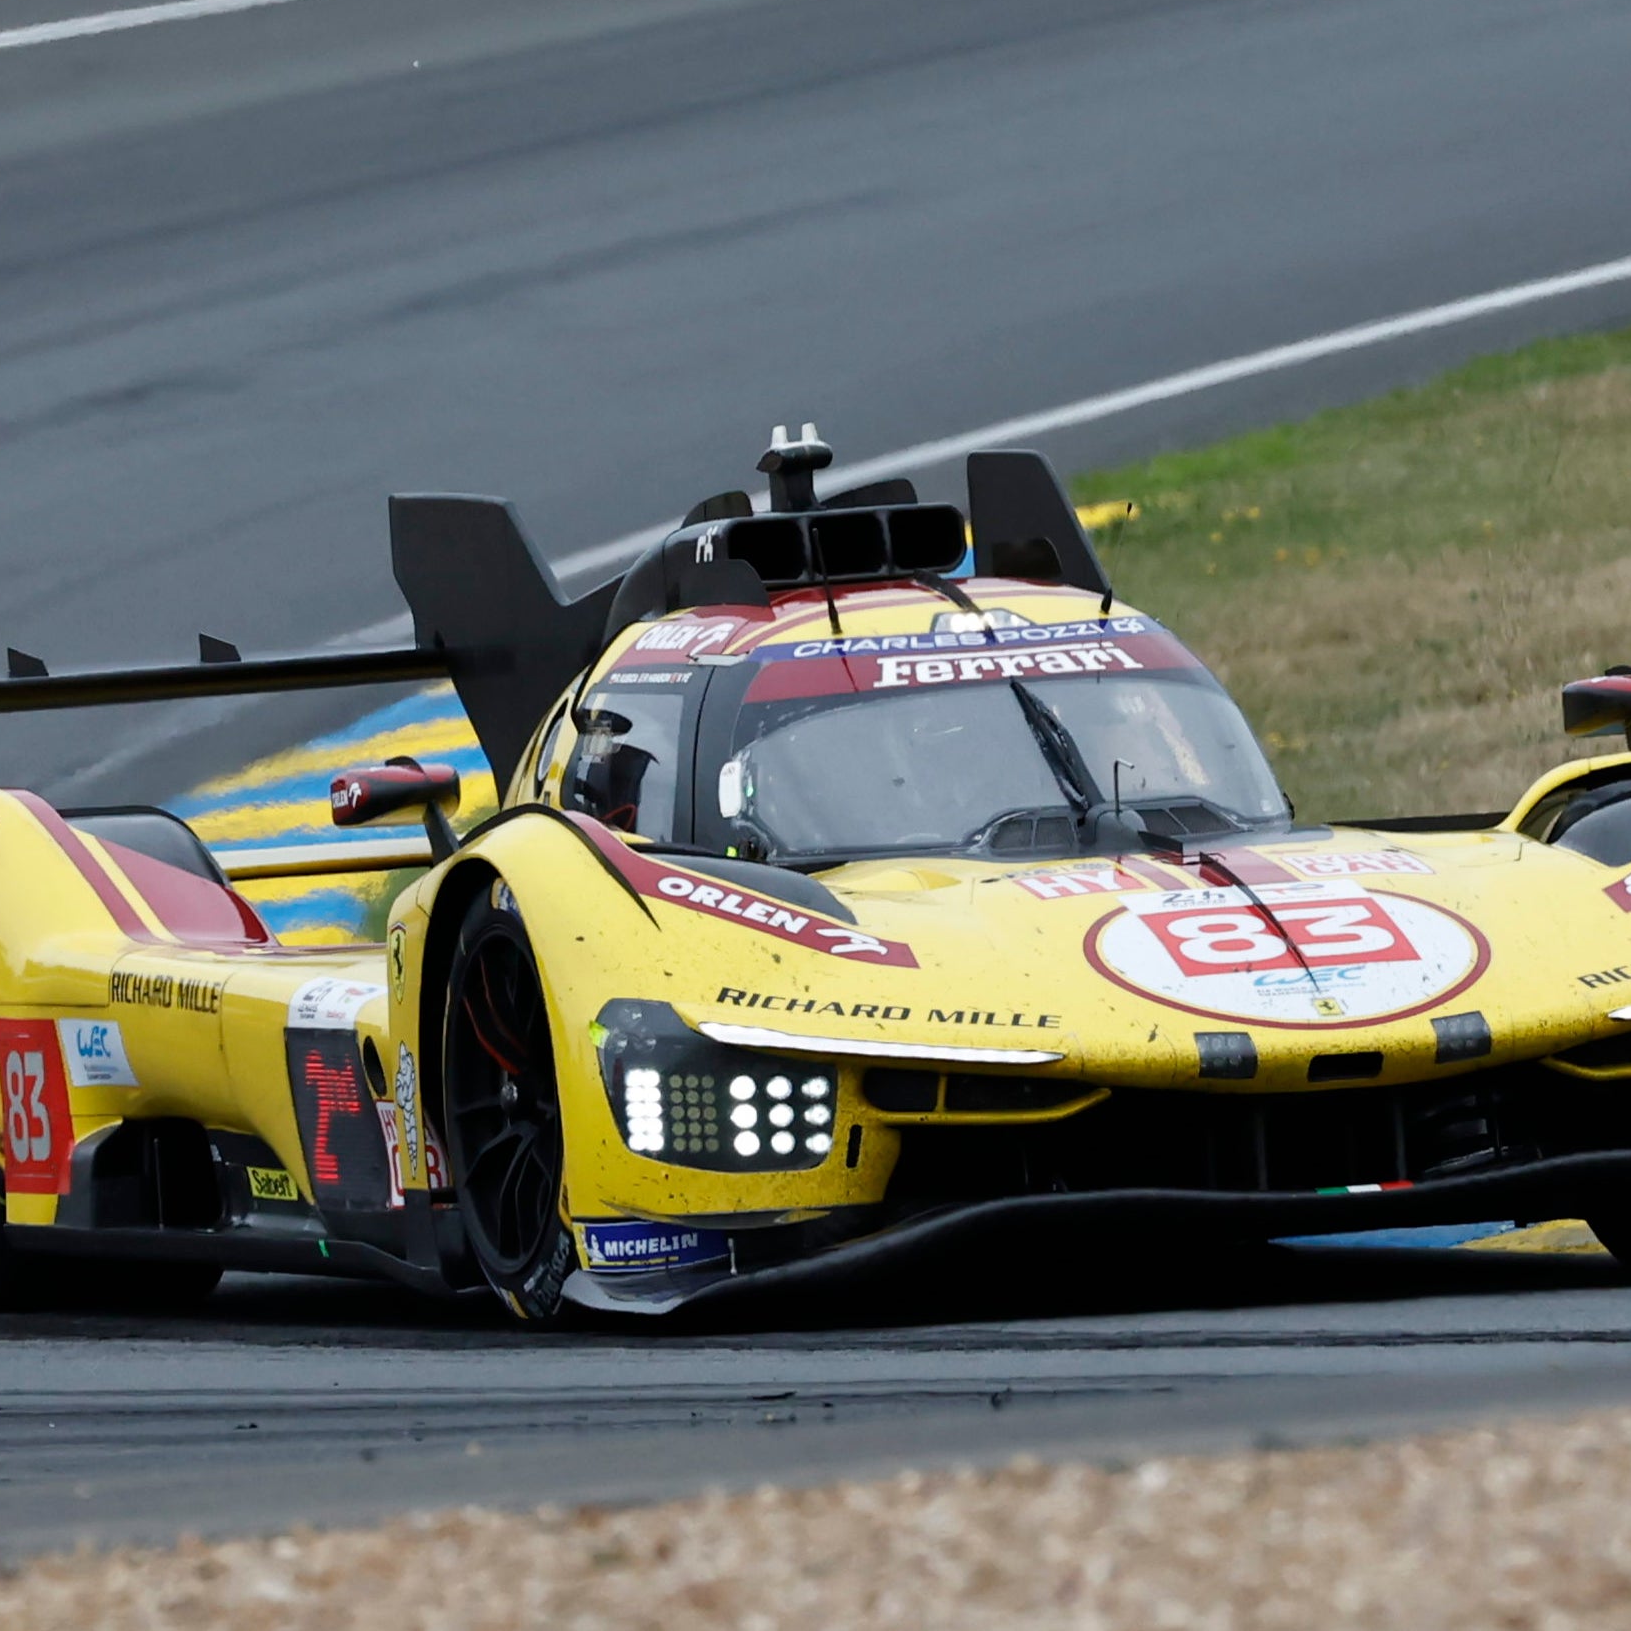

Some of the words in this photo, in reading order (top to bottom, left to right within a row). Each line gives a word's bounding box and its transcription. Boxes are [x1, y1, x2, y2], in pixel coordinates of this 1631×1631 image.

[635, 624, 704, 651] ORLEN
[793, 632, 986, 658] CHARLES
[994, 621, 1104, 643] POZZI
[873, 642, 1143, 688] Ferrari
[658, 877, 809, 935] ORLEN
[1166, 904, 1396, 965] 83
[111, 971, 173, 1007] RICHARD
[177, 977, 220, 1014] MILLE
[716, 986, 912, 1023] RICHARD
[927, 1008, 1064, 1029] MILLE
[6, 1050, 52, 1163] 83
[604, 1232, 699, 1257] MICHELIN
